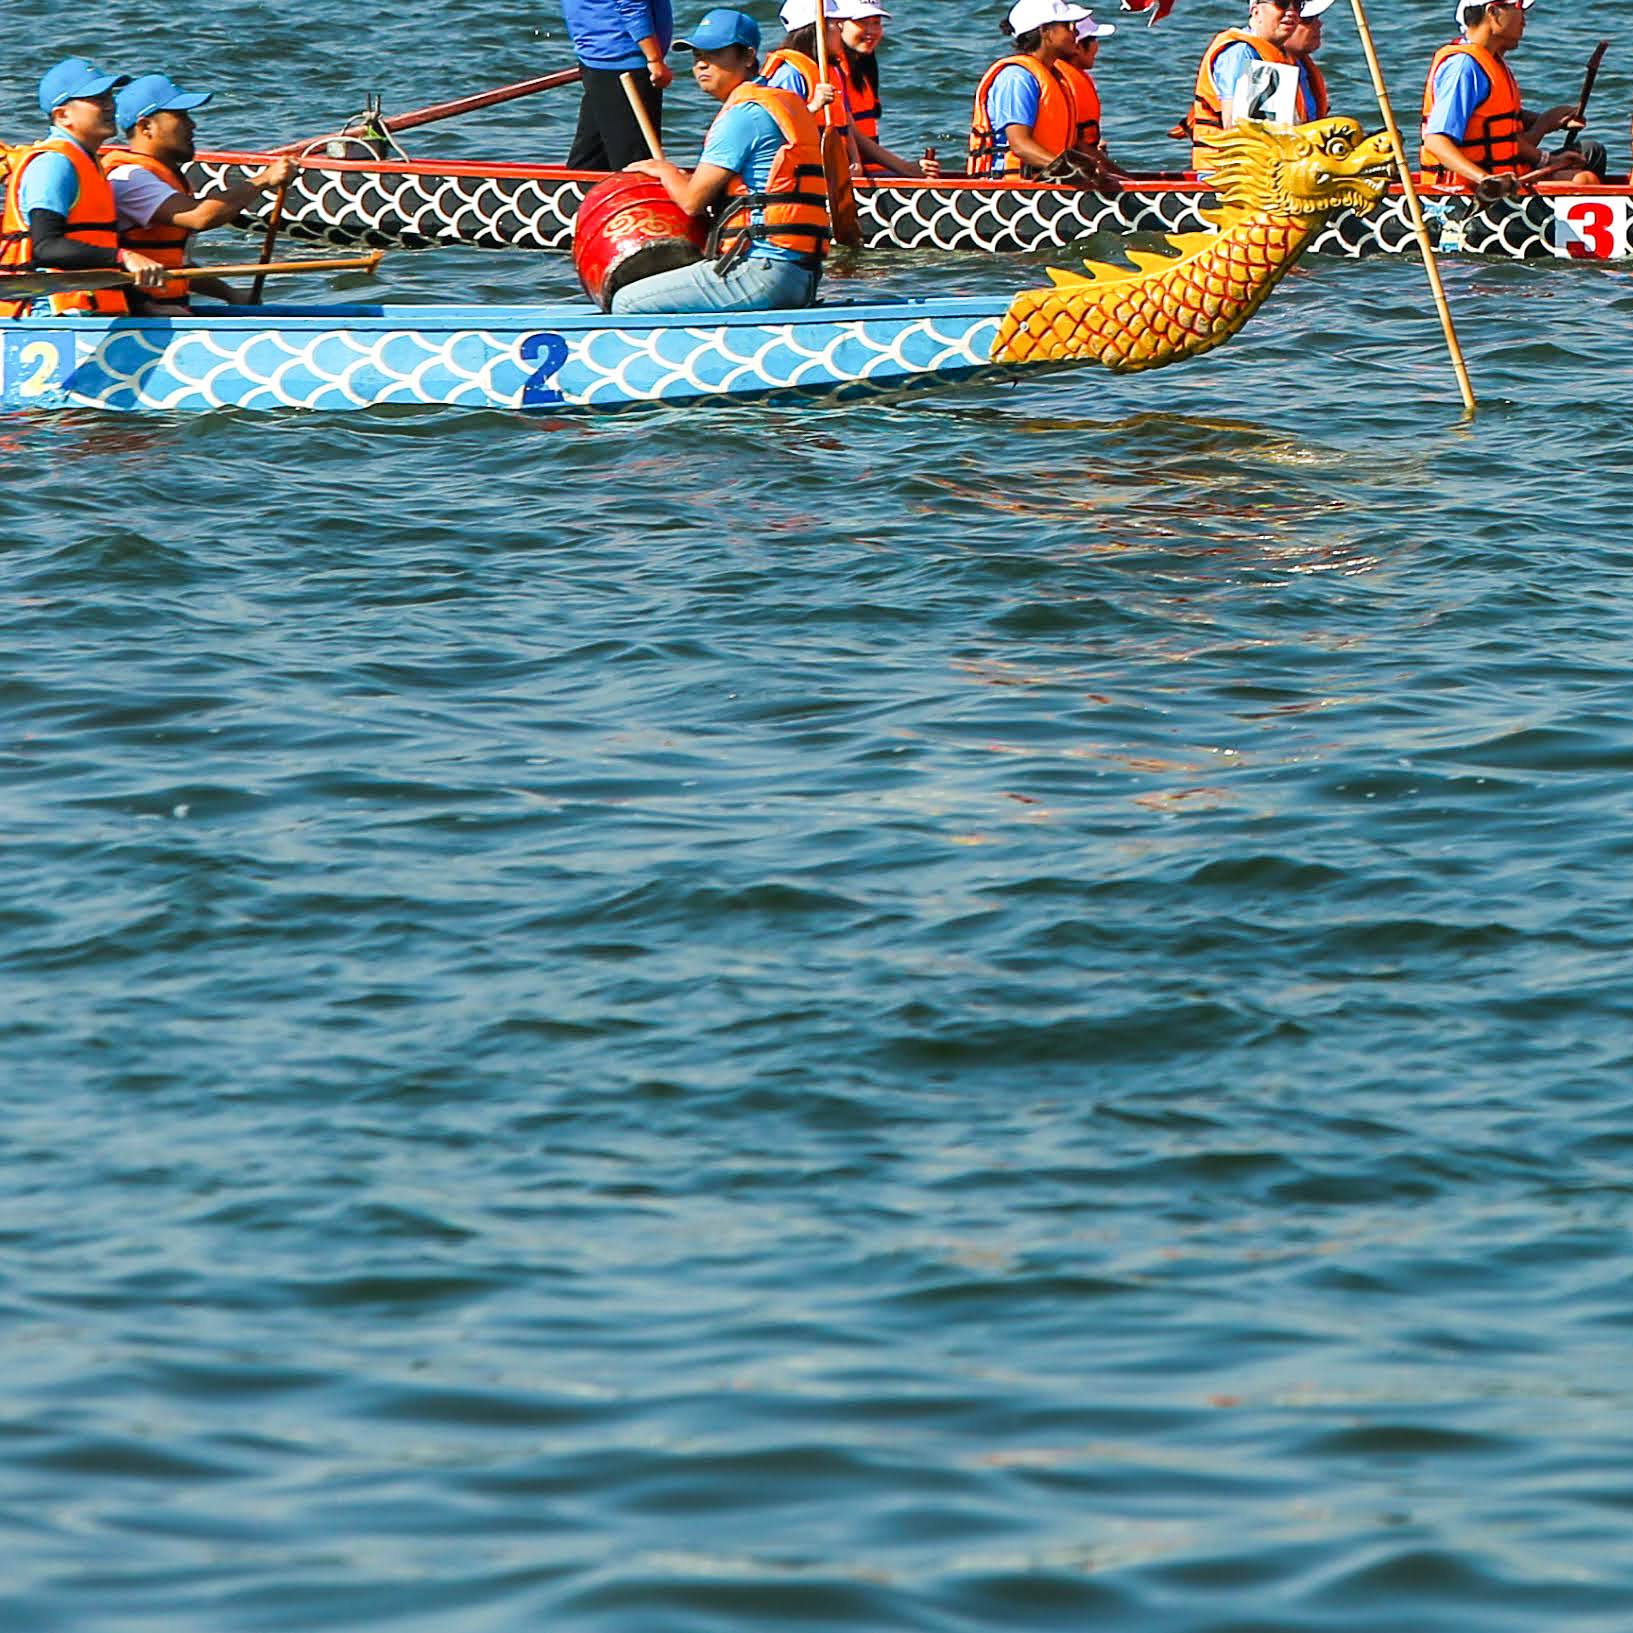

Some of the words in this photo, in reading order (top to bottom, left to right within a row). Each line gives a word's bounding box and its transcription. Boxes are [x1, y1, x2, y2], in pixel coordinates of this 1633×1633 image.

[1248, 66, 1280, 121] 2
[1567, 202, 1615, 261] 3
[19, 341, 61, 397] 2
[519, 333, 569, 404] 2
